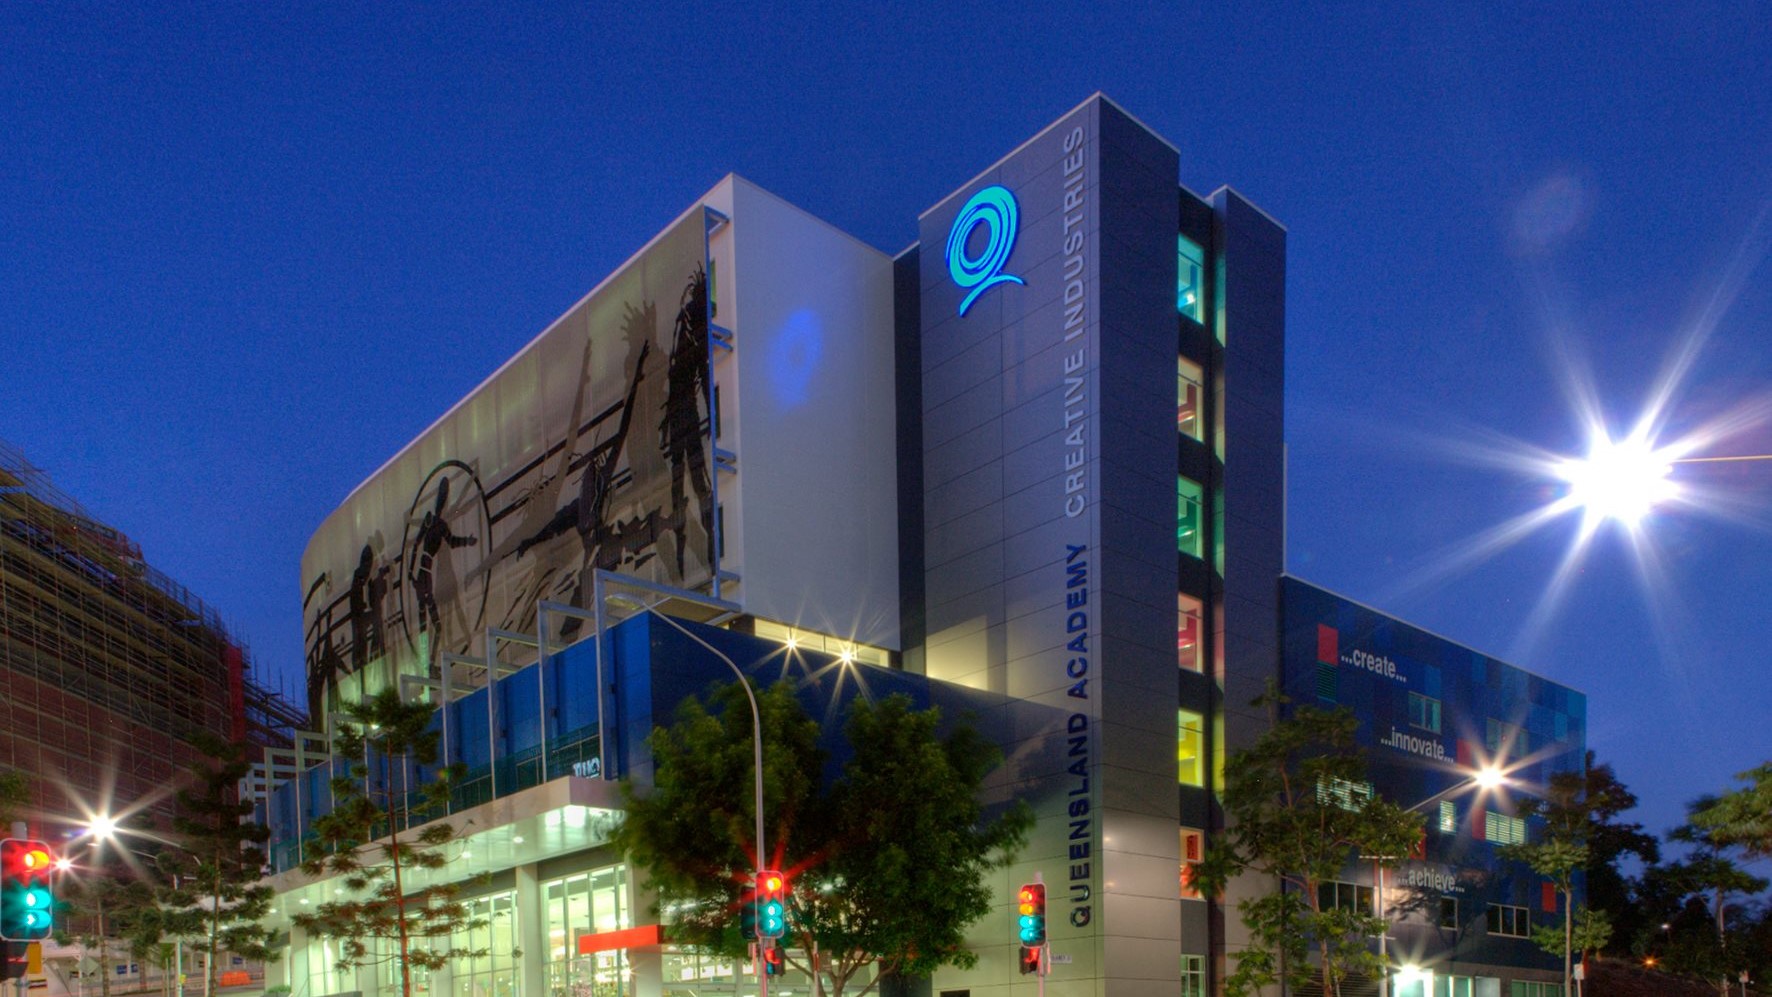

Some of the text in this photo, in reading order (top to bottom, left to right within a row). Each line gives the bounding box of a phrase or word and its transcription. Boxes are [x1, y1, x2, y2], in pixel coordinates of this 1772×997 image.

[1064, 126, 1091, 928] QUEENSLAND ACADEMY CREATIVE INDUSTRIES
[1341, 649, 1407, 683] ...create...
[1380, 726, 1454, 763] ...innovate...
